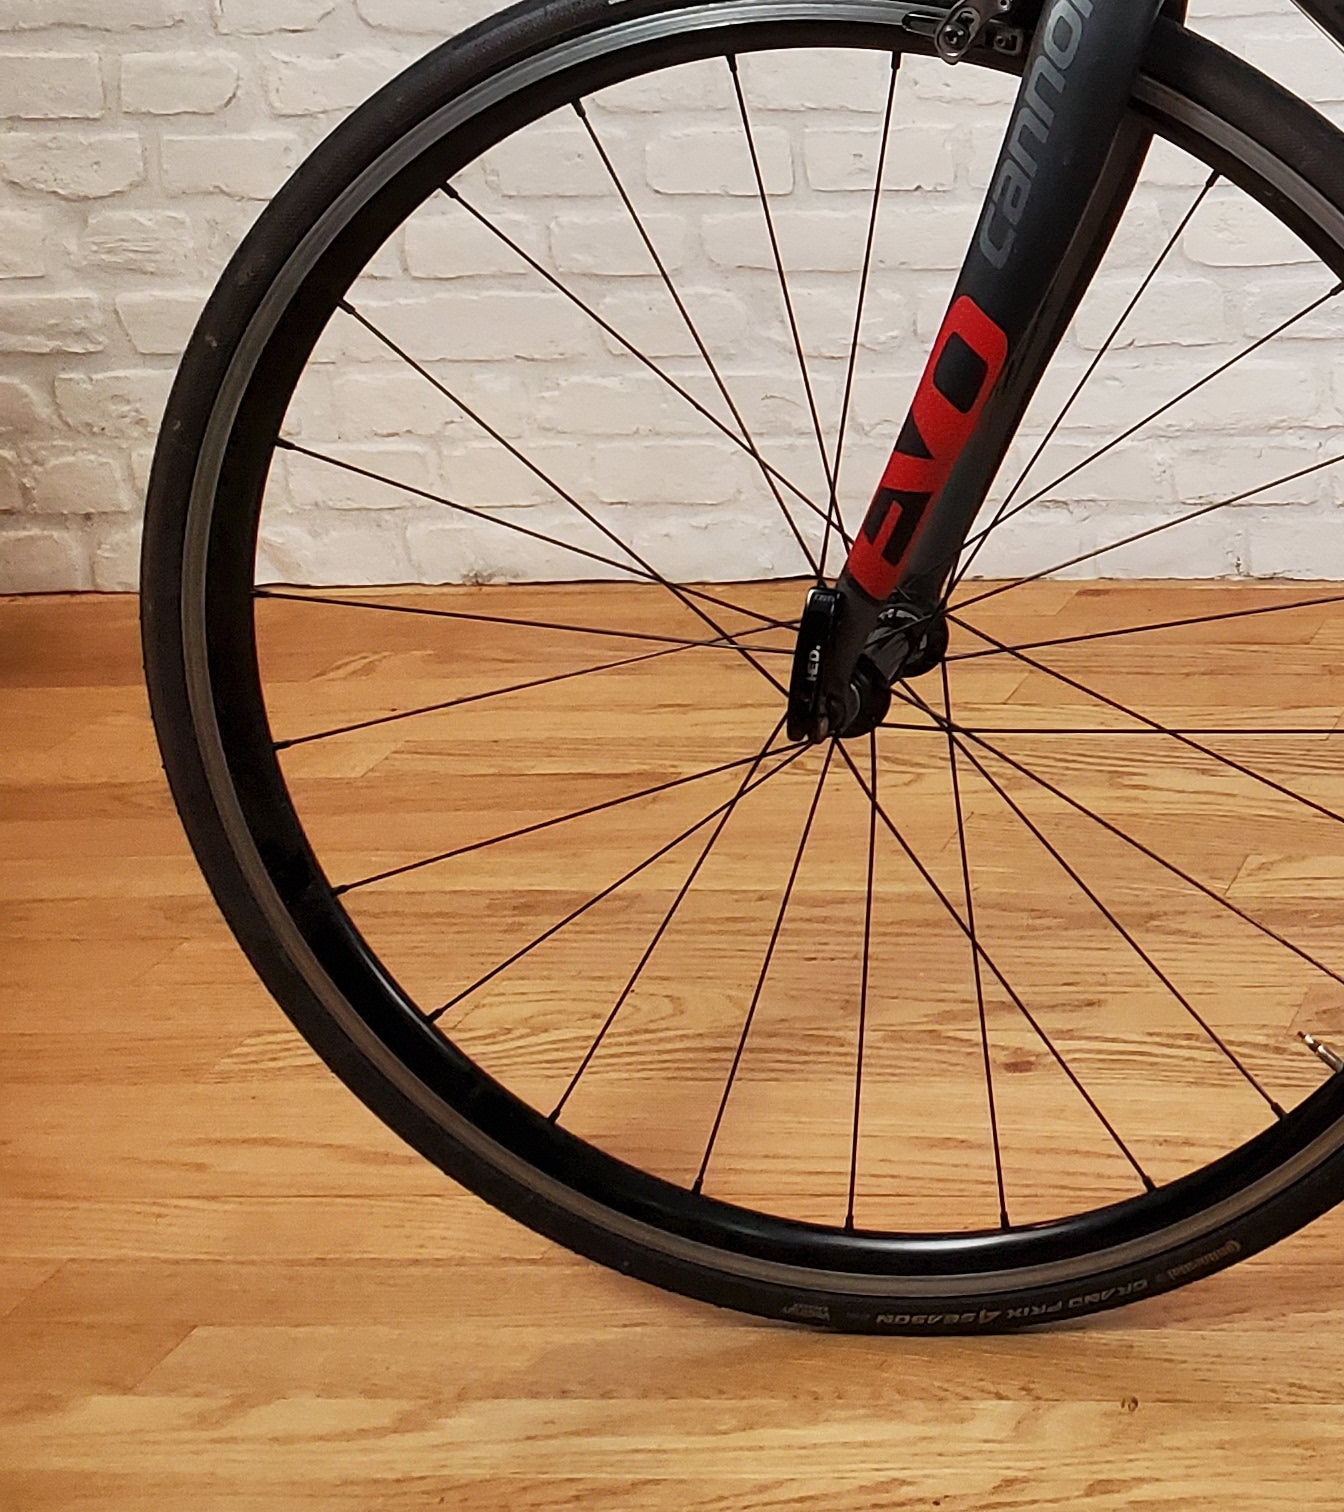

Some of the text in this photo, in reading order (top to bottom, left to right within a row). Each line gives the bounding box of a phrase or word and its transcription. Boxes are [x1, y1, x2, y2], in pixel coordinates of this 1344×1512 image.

[848, 293, 1009, 601] EVO
[1006, 1299, 1063, 1320] PRIX
[1067, 1278, 1149, 1310] GRAND
